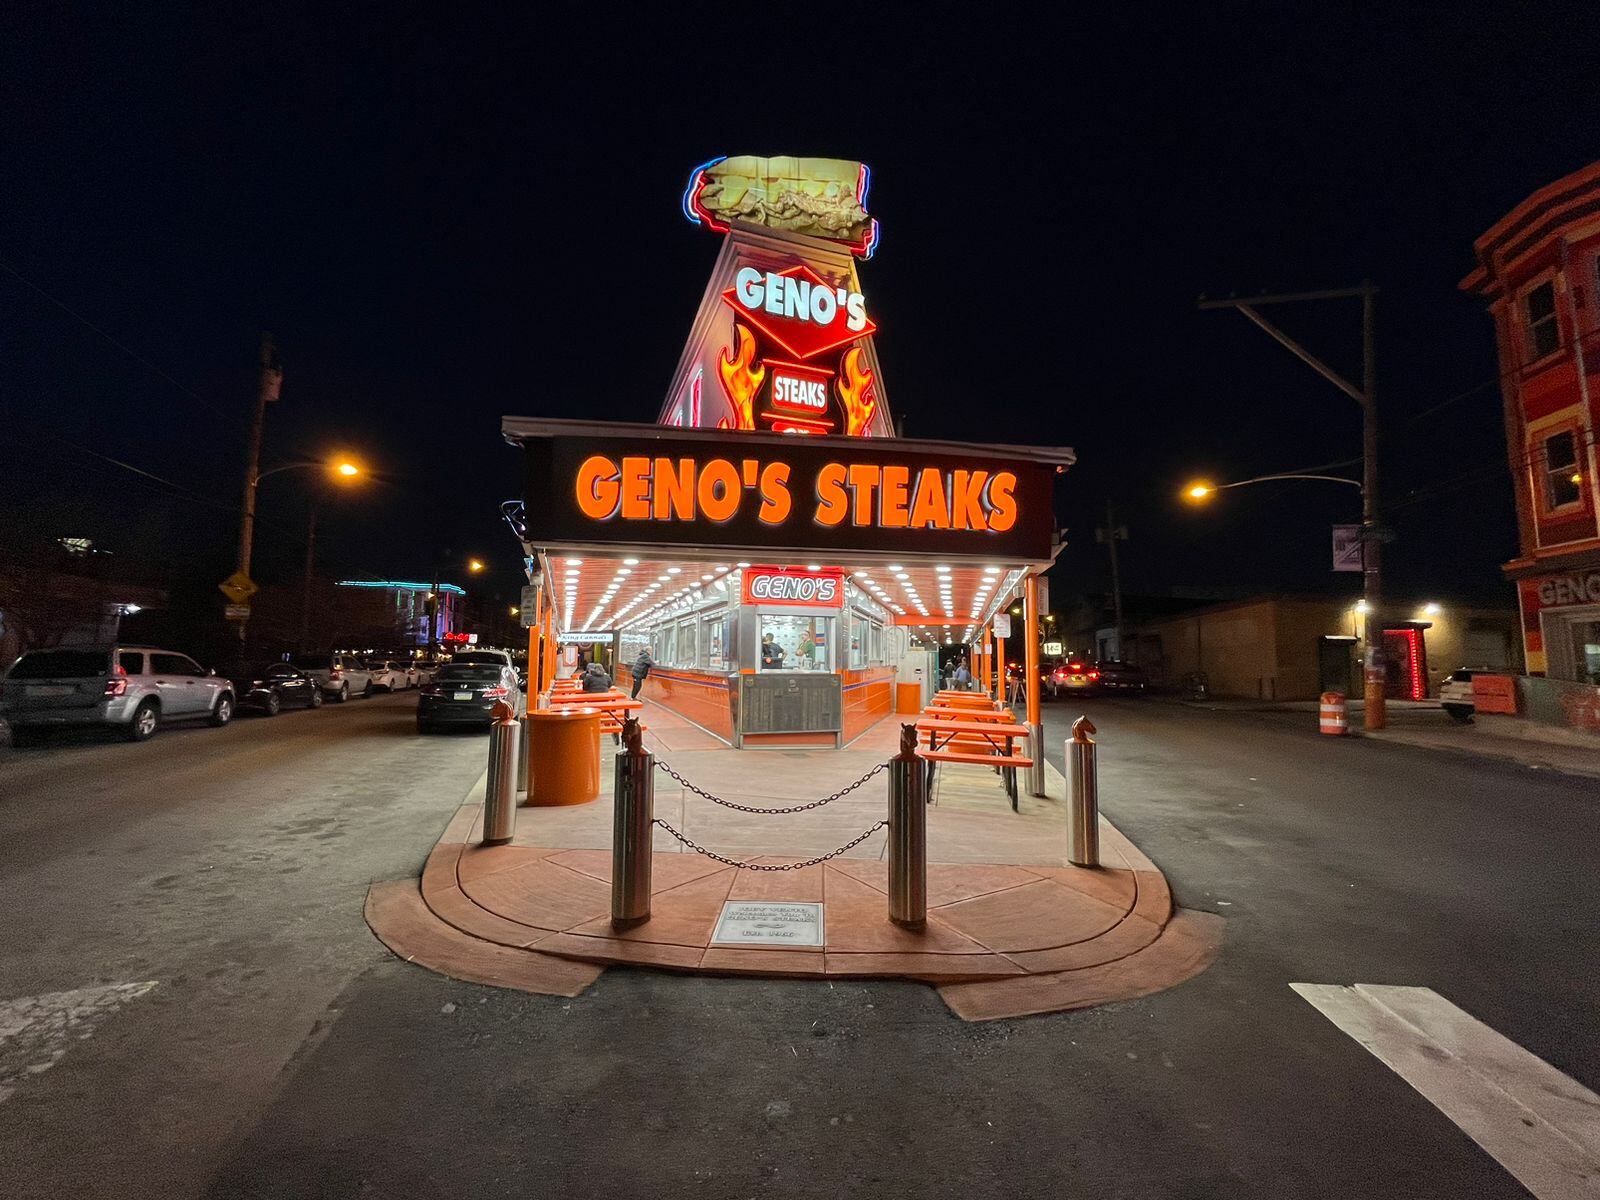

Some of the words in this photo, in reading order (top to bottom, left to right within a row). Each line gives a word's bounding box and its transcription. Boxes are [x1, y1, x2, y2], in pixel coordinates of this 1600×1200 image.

[735, 266, 867, 332] GENO'S
[774, 375, 826, 408] STEAKS
[575, 455, 792, 525] GENO'S
[814, 462, 1018, 533] STEAKS
[751, 574, 836, 601] GENO'S
